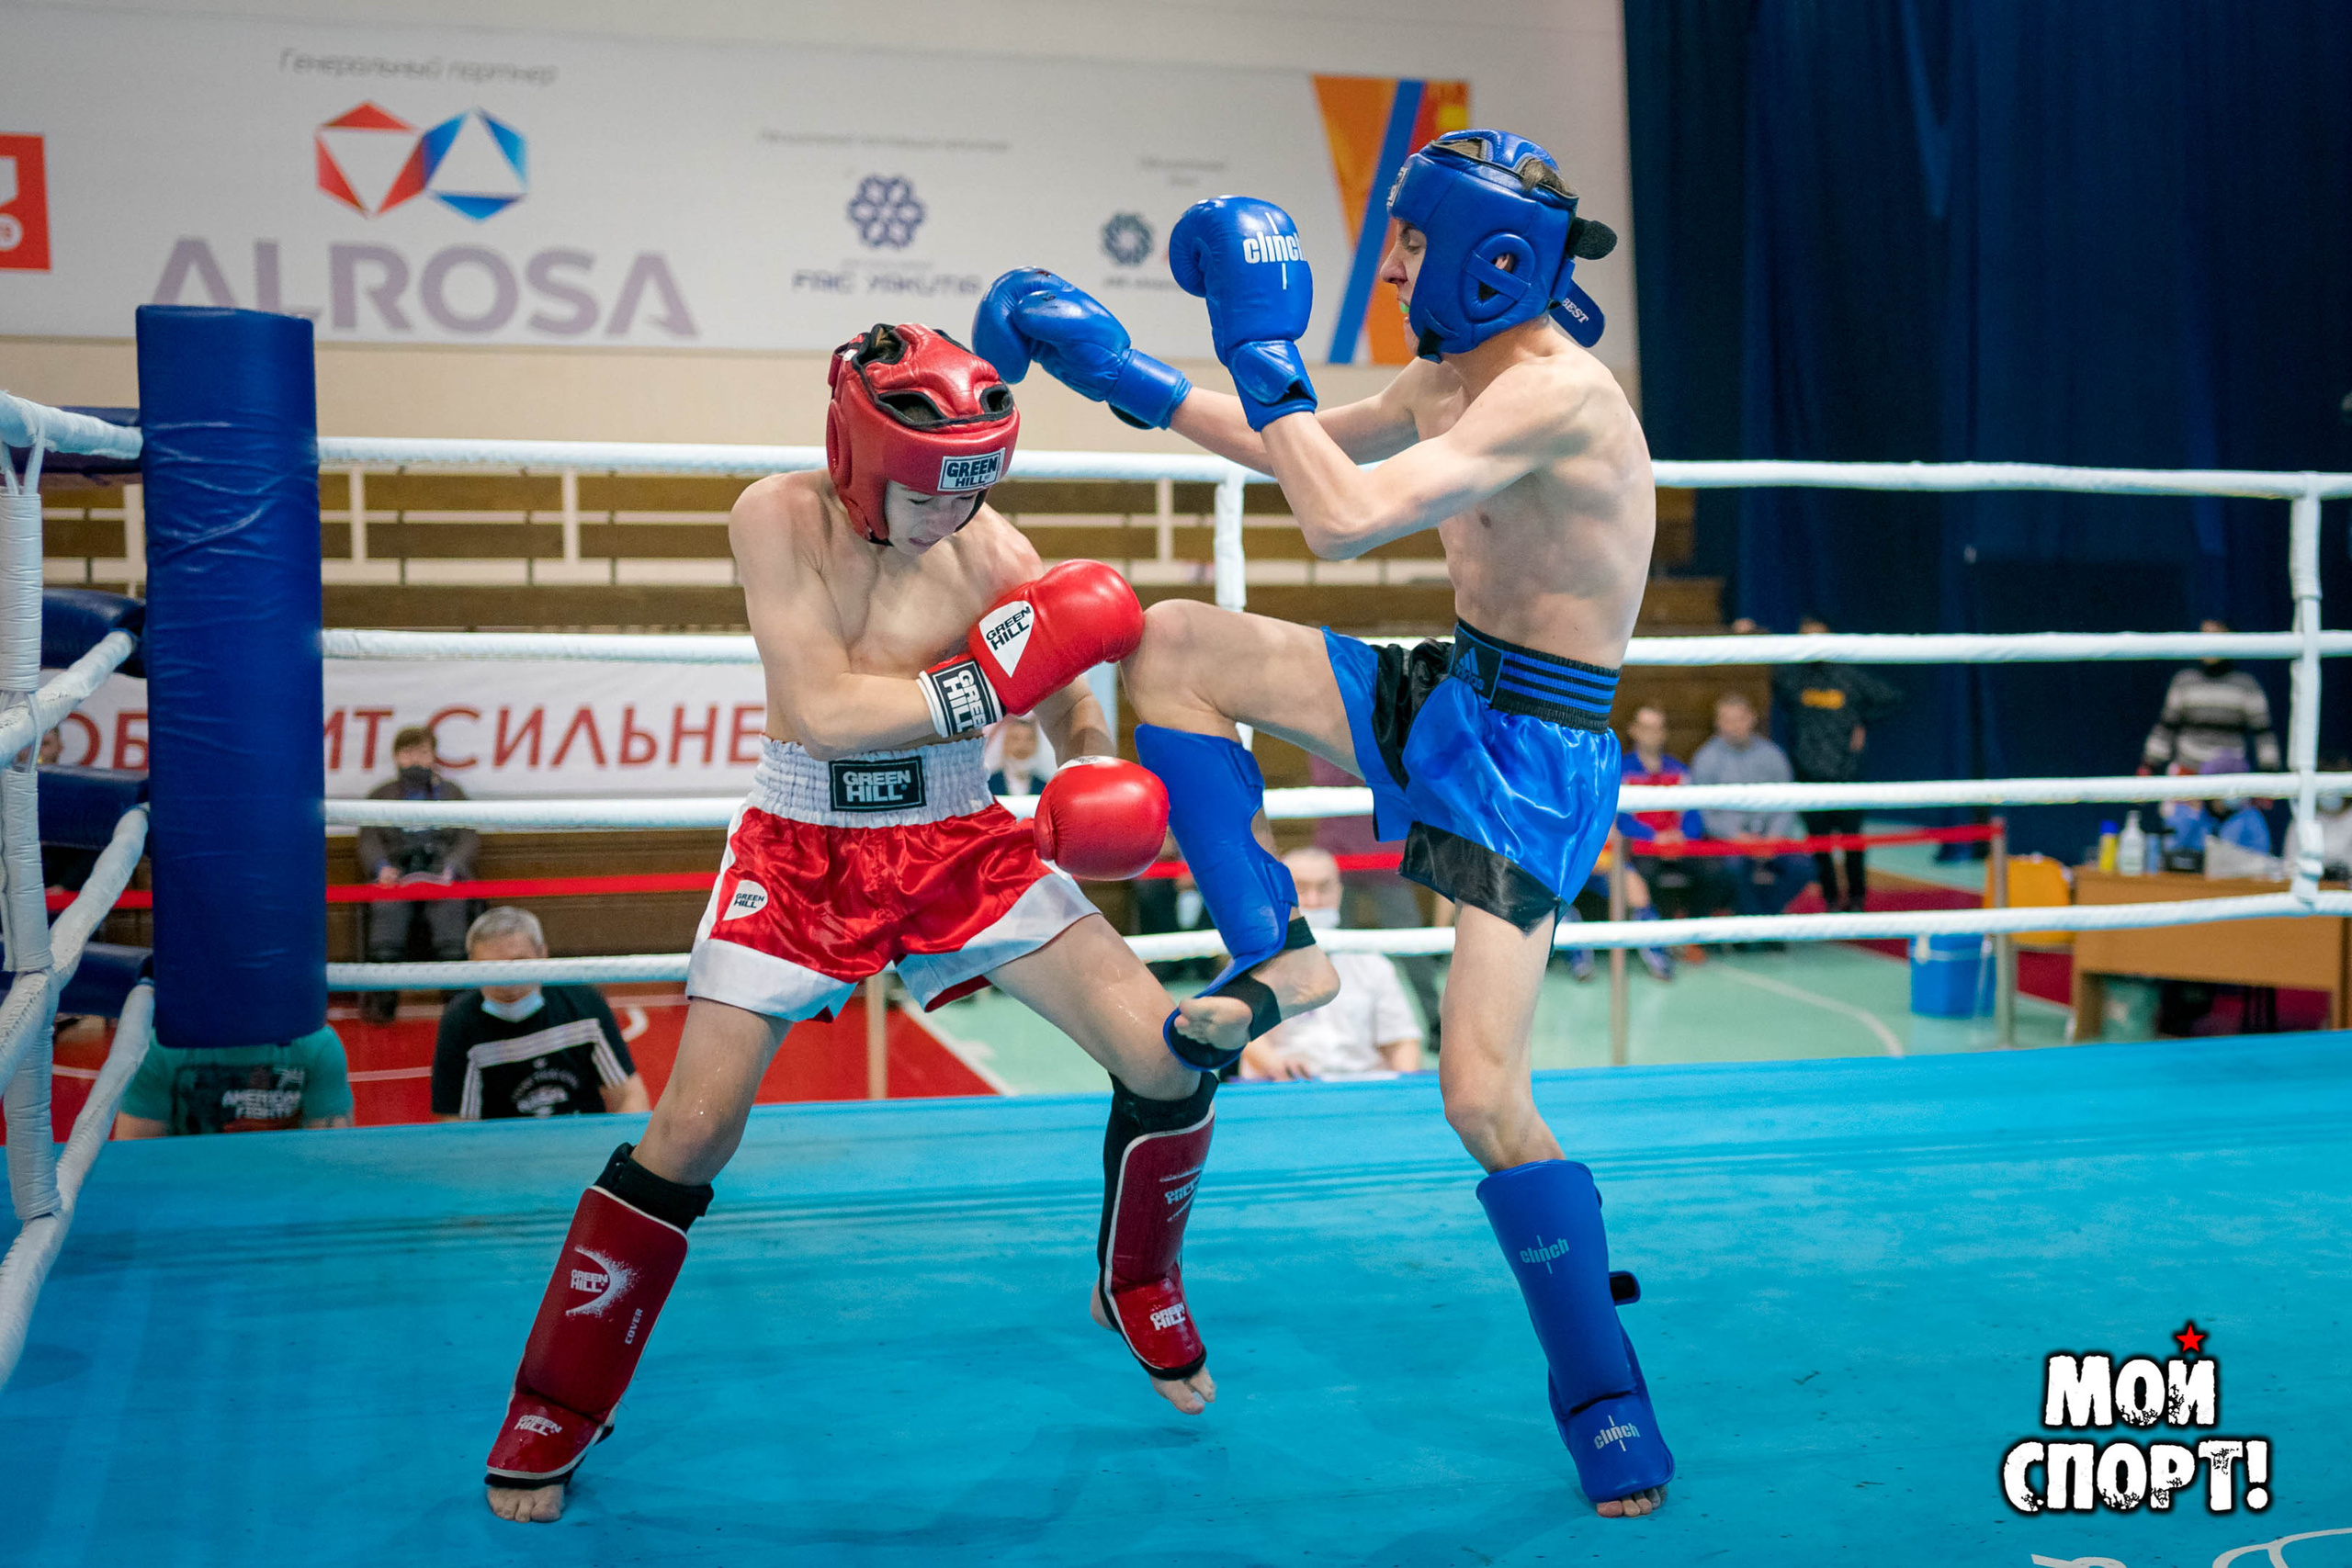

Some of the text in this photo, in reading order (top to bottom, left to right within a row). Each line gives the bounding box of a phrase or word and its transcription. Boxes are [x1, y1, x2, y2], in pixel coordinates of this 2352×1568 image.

[153, 236, 701, 337] ALROSA
[1562, 298, 1589, 323] BEST
[946, 457, 999, 478] GREEN
[955, 475, 986, 487] HILL
[986, 606, 1032, 641] GREEN
[990, 621, 1030, 650] HILL
[958, 670, 988, 730] GREE
[842, 770, 911, 785] GREEN
[846, 784, 903, 803] HILL
[733, 898, 757, 908] HILL
[735, 892, 765, 903] GREEN
[1520, 1237, 1570, 1264] clinch
[570, 1278, 603, 1293] HILL
[571, 1269, 608, 1283] GREEN
[625, 1308, 643, 1345] COVER
[1594, 1423, 1641, 1450] clinch
